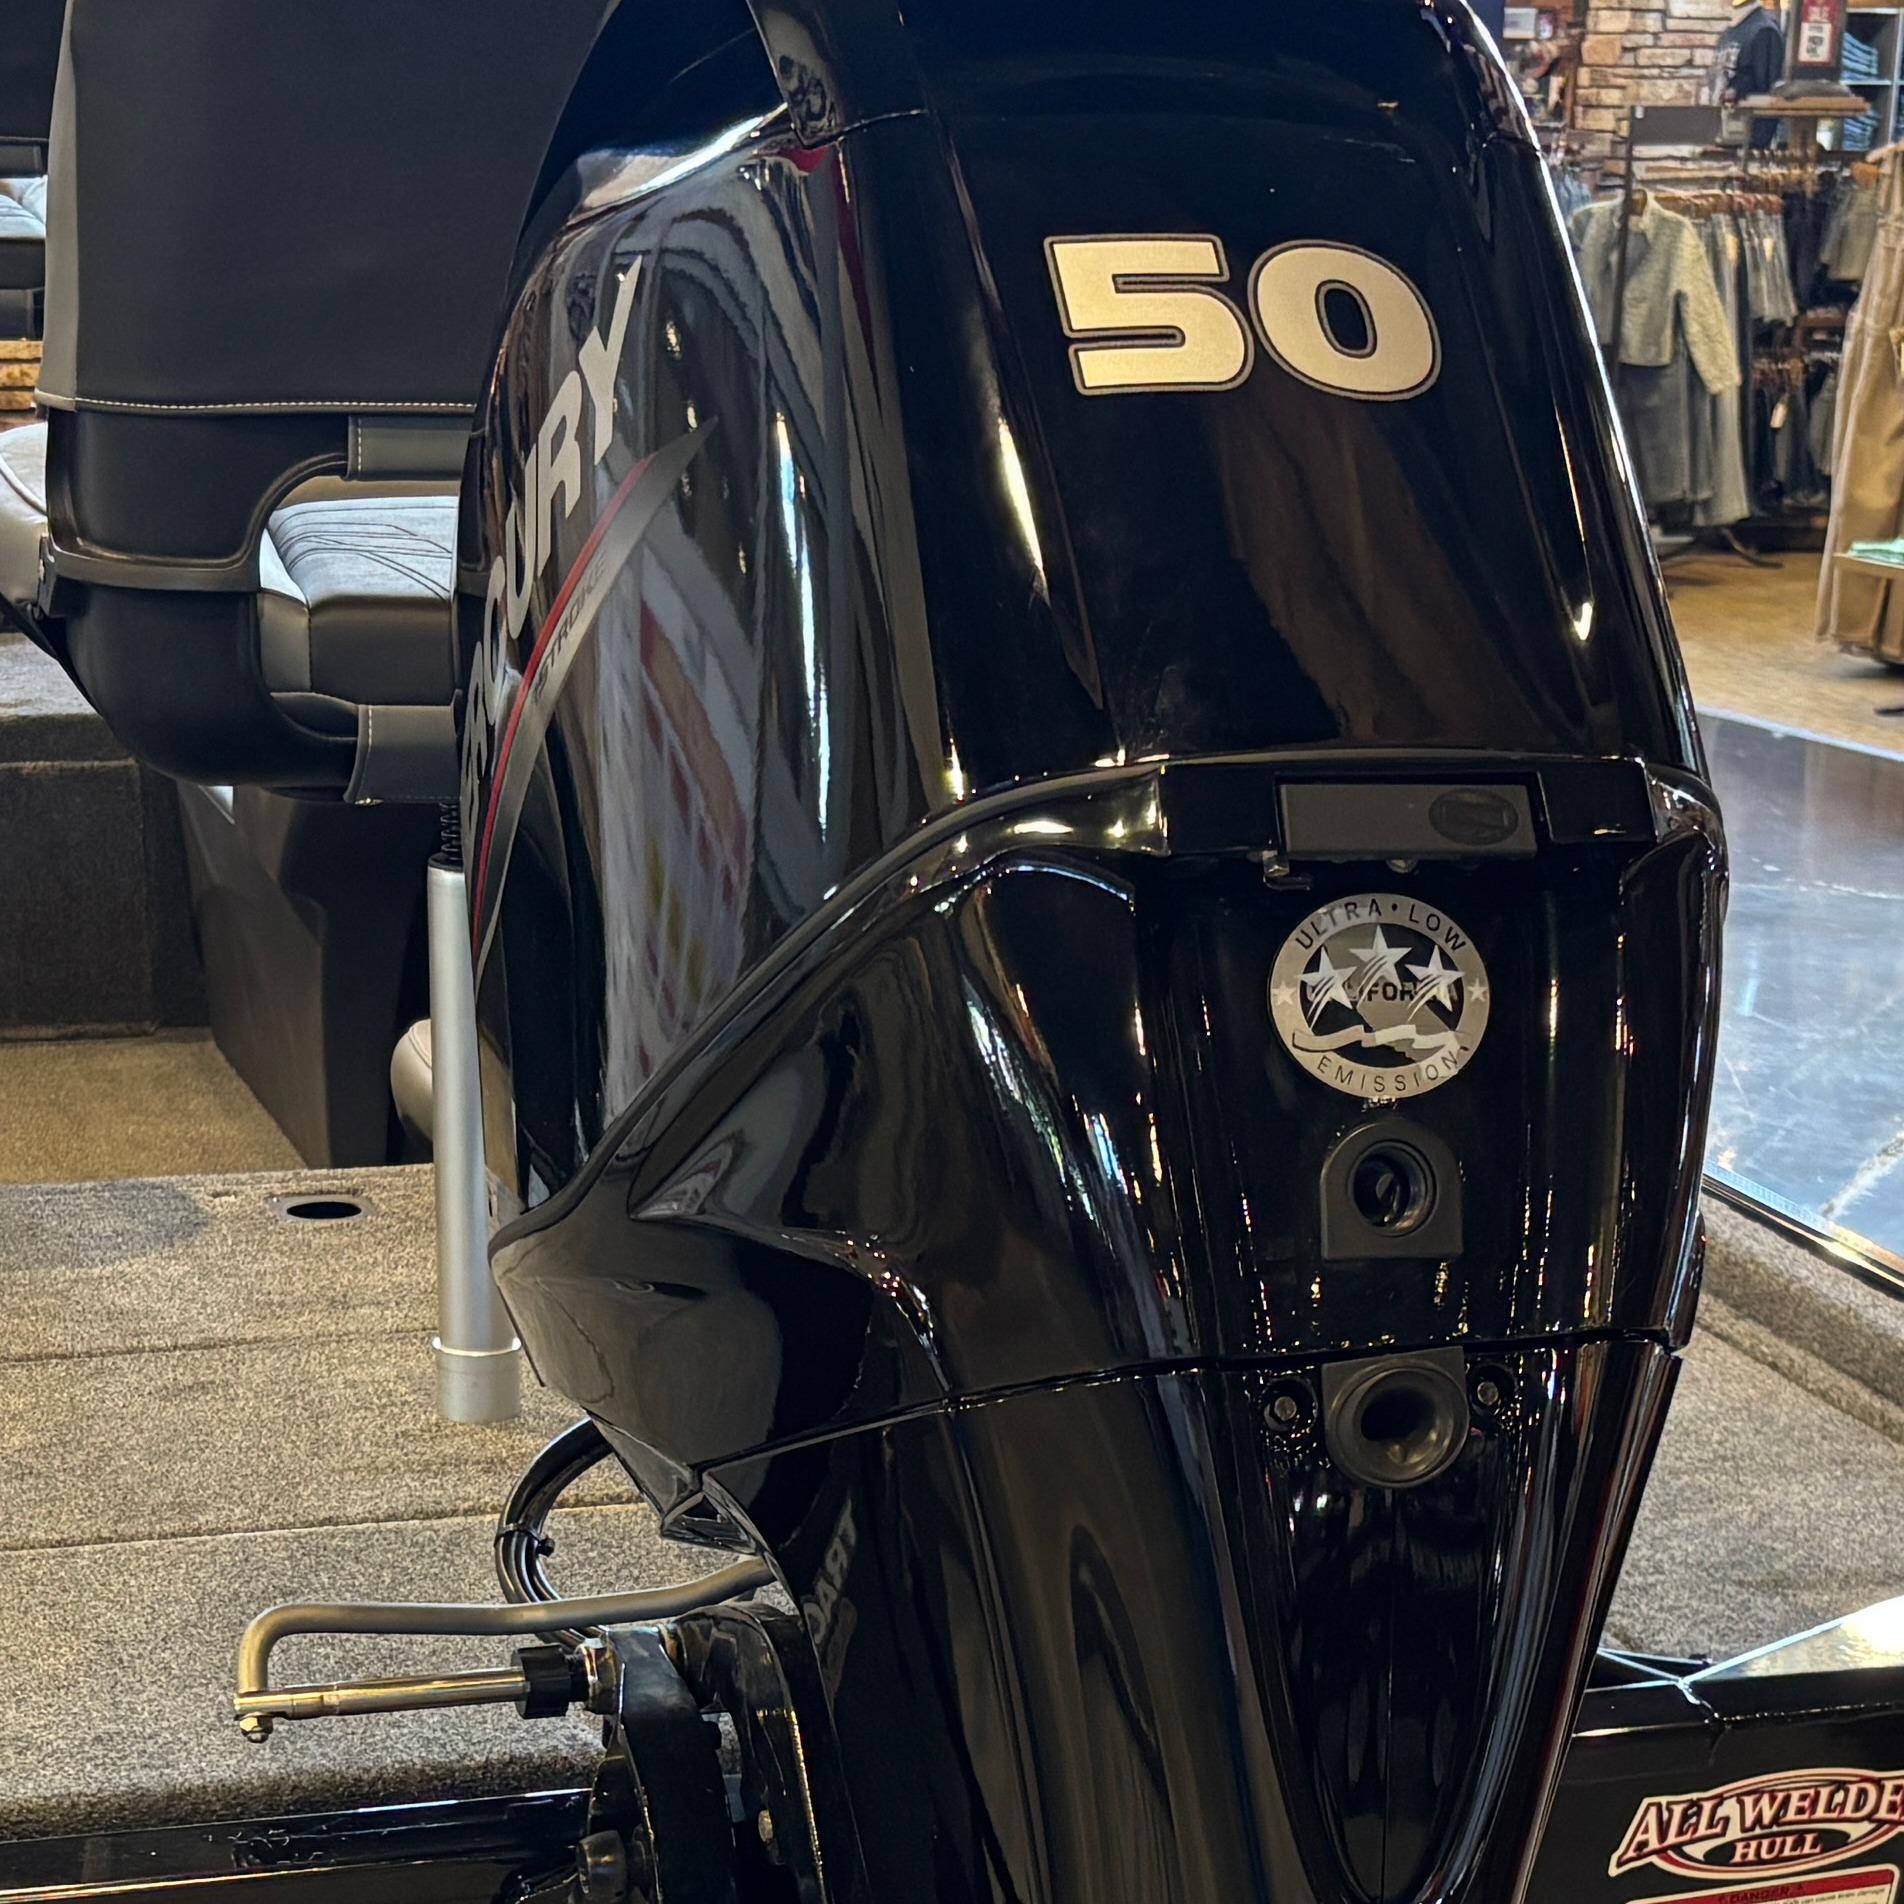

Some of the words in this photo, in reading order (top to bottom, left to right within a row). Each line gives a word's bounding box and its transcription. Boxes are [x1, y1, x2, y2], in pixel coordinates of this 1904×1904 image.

[1044, 233, 1441, 400] 50
[1296, 897, 1384, 952] ULTRA
[1408, 902, 1467, 953] LOW
[1317, 1053, 1462, 1093] EMISSION
[1617, 1803, 1731, 1865] ALL
[1732, 1831, 1824, 1864] HULL
